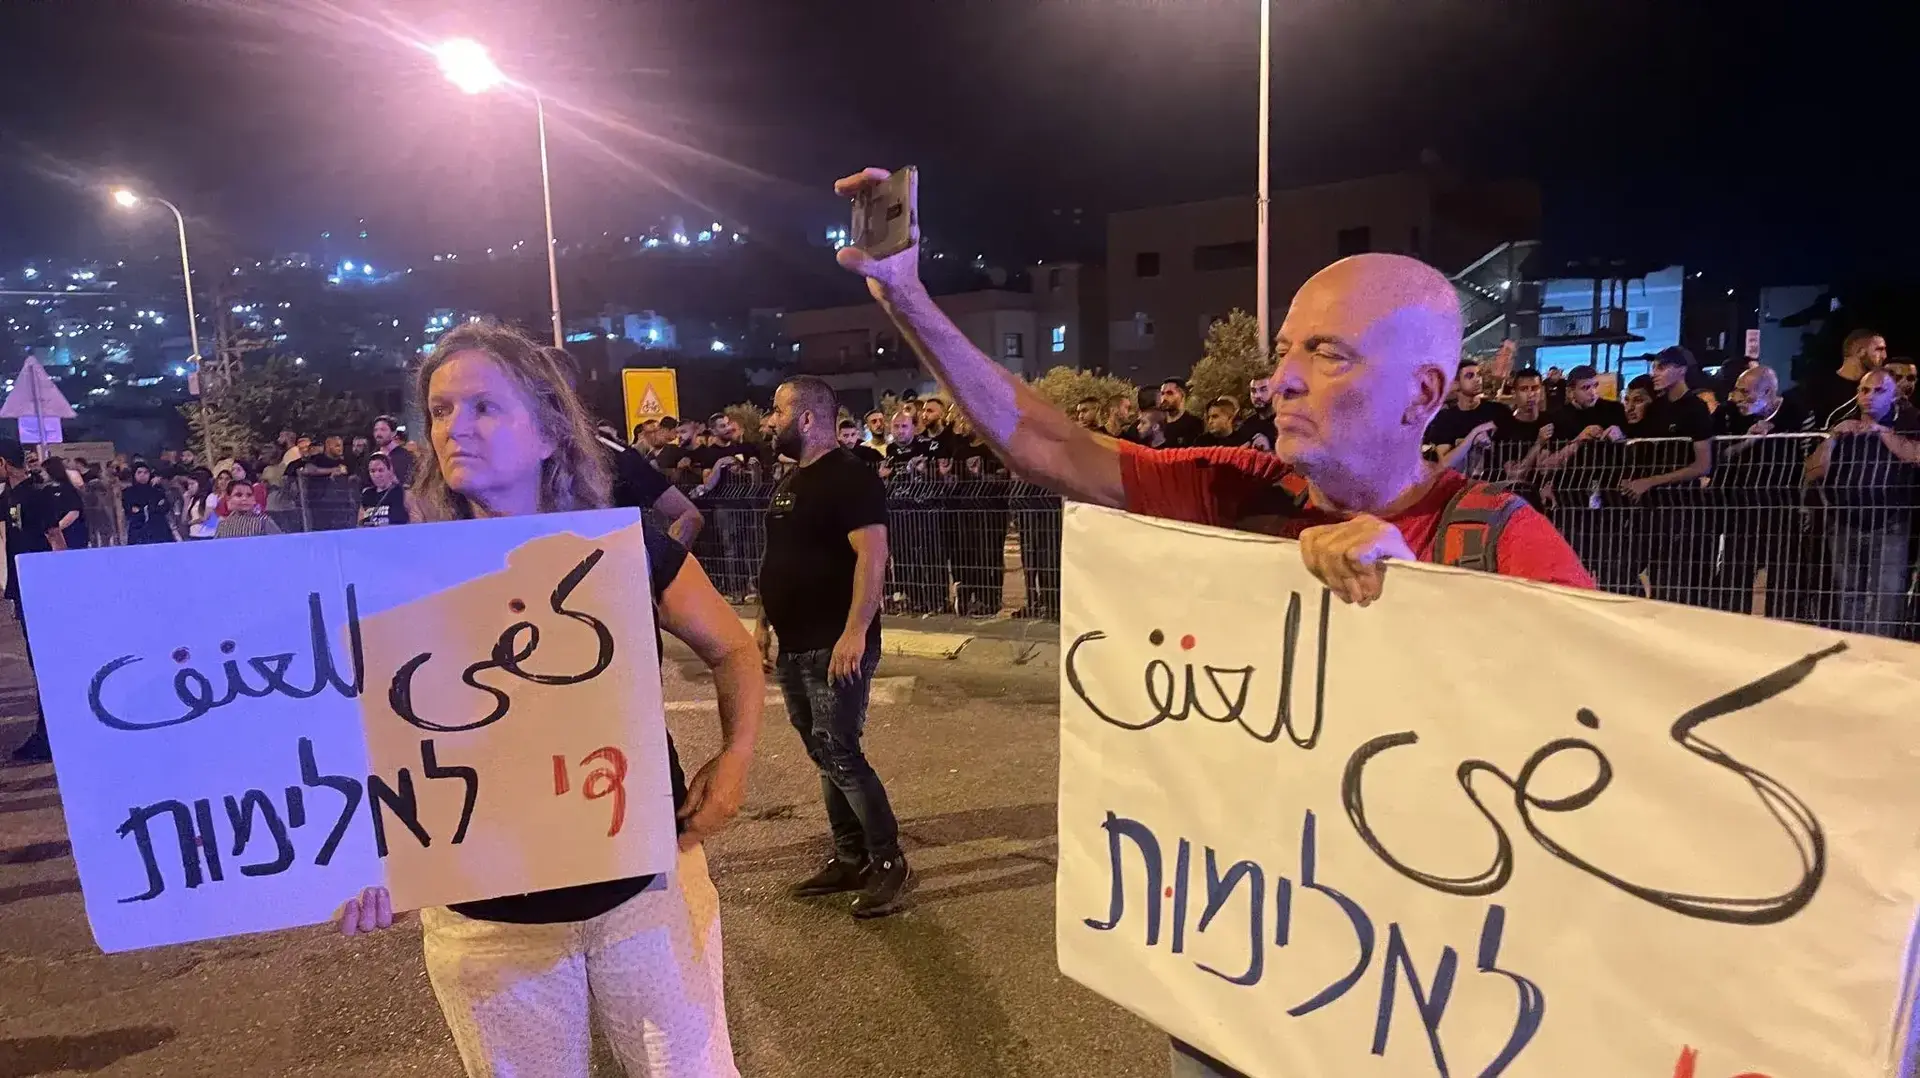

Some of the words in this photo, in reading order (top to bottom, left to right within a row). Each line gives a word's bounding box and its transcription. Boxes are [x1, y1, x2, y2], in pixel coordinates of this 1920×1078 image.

[87, 582, 365, 731] للعنف
[388, 548, 615, 732] كفى
[1065, 587, 1331, 750] للعنف
[1341, 639, 1849, 925] كفى
